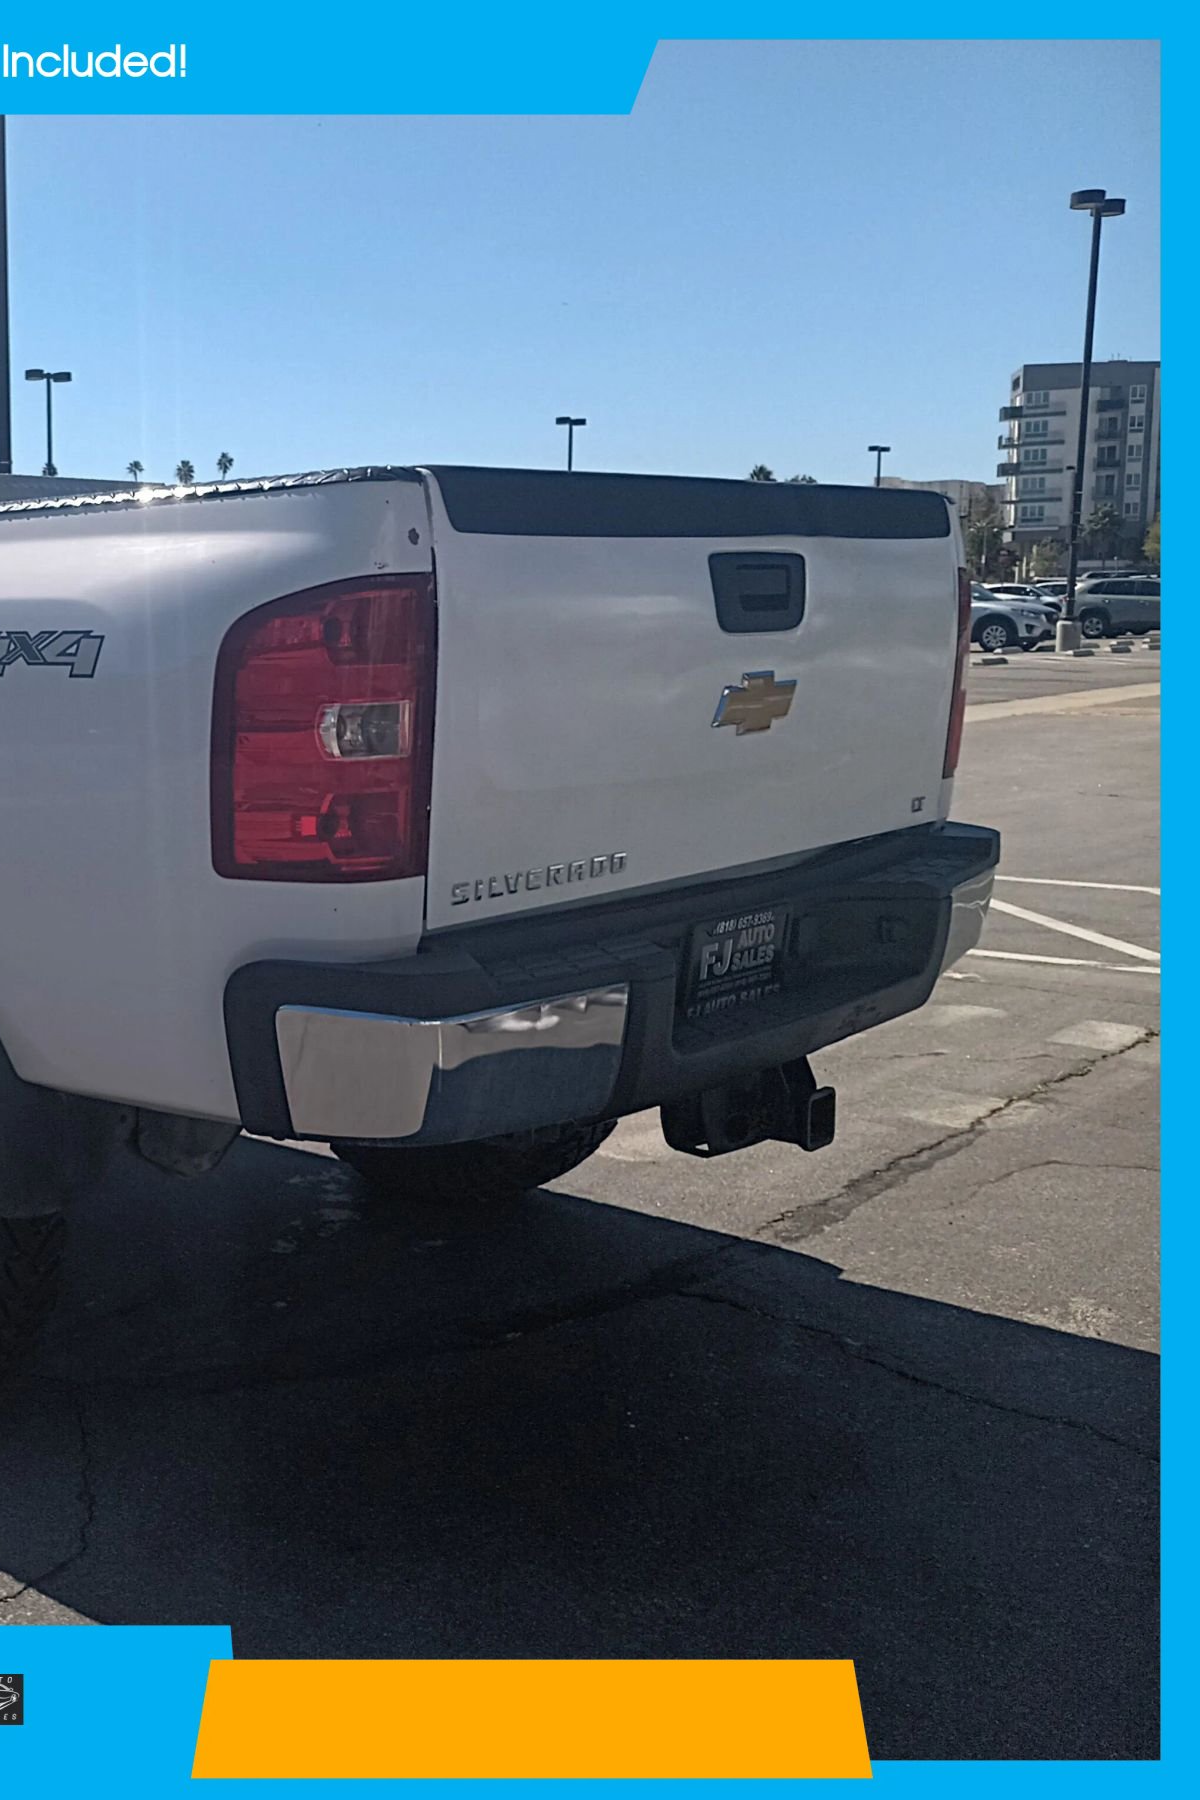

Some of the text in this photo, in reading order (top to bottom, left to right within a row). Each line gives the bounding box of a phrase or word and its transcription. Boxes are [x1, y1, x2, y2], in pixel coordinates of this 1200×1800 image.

[451, 851, 627, 906] SILVERADO
[736, 923, 775, 950] AUTO
[700, 938, 733, 981] FJ
[730, 944, 775, 972] SALES
